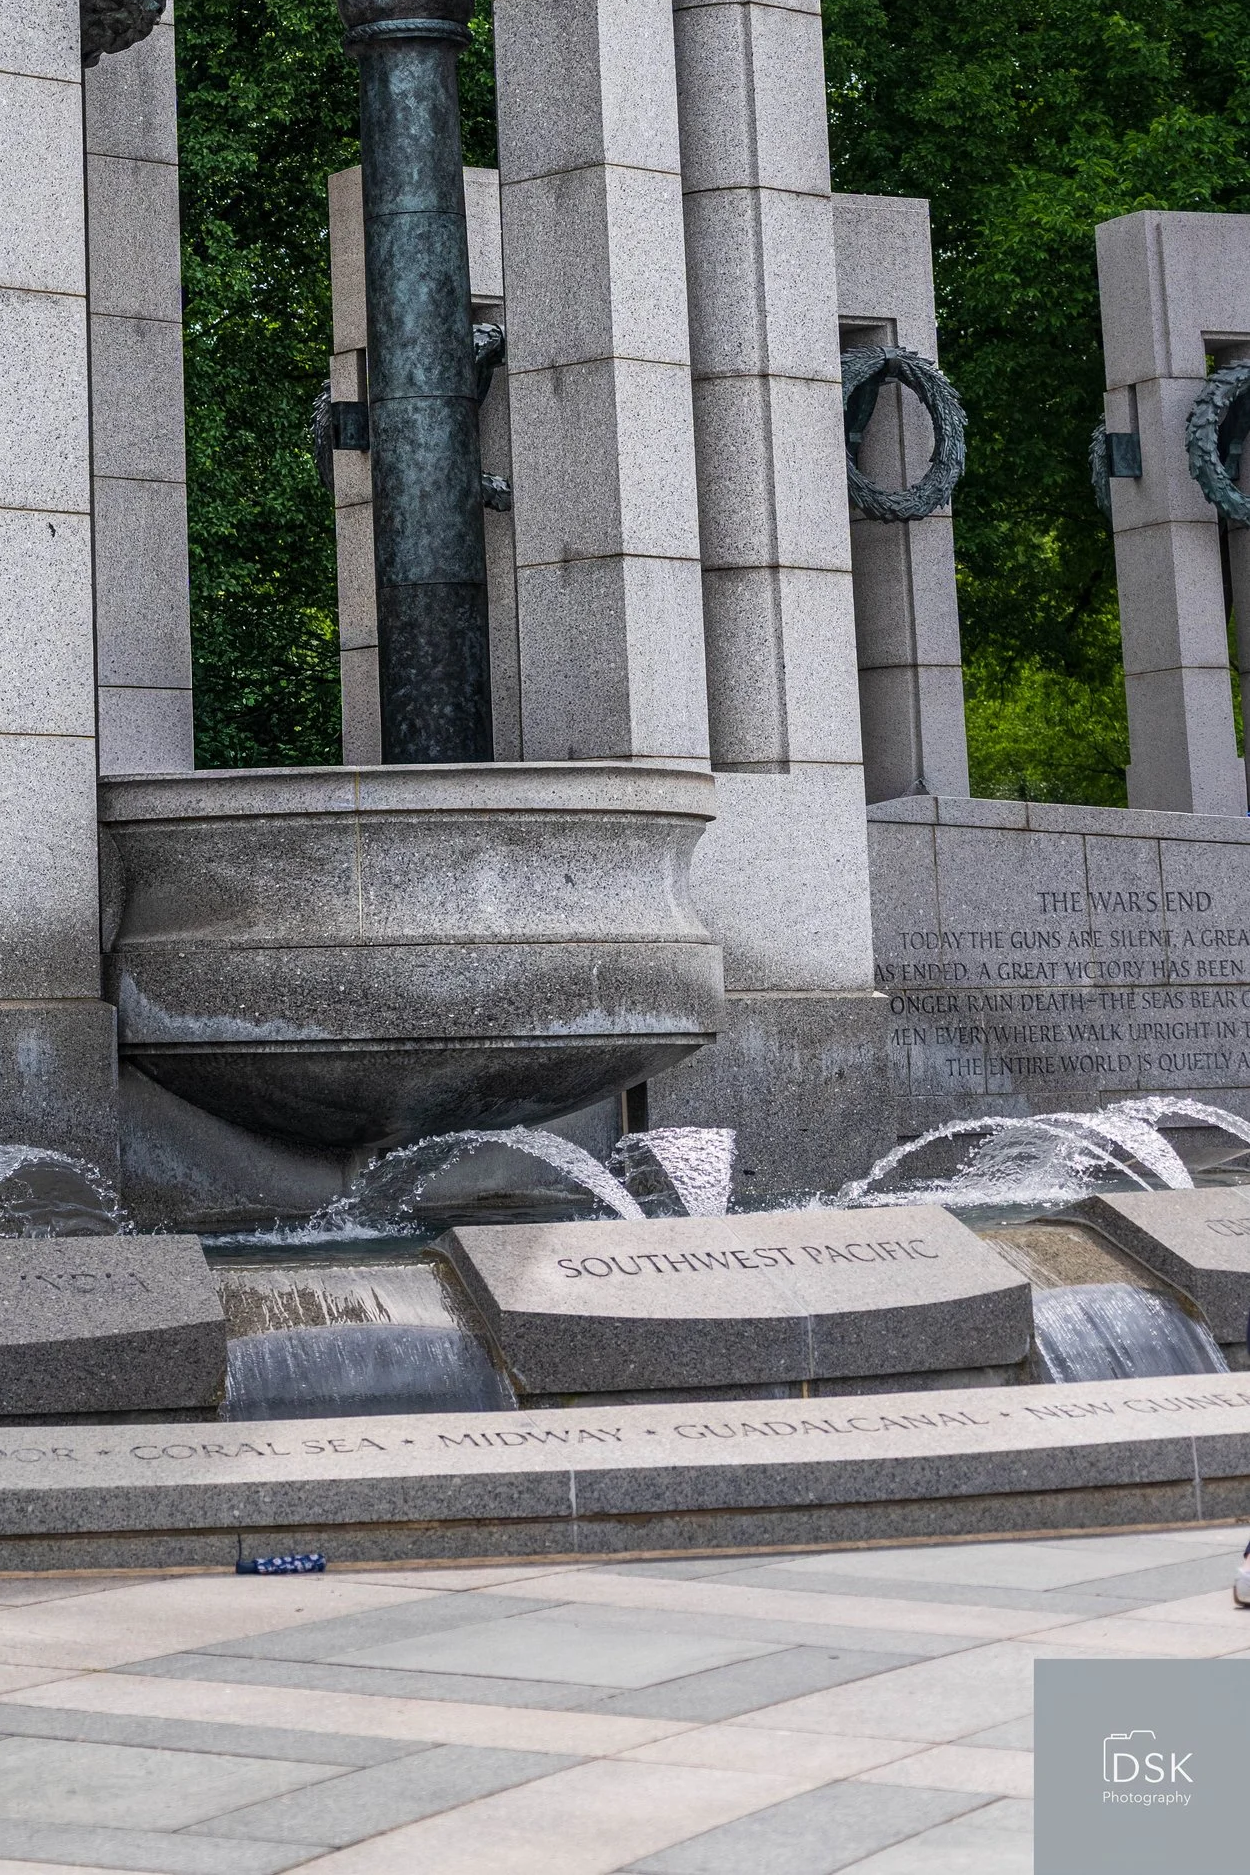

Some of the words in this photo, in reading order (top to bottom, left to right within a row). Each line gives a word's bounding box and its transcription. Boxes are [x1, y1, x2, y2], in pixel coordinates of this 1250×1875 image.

[1037, 892, 1083, 913] THE
[1089, 891, 1158, 913] WAR'S
[1165, 891, 1212, 912] END
[900, 931, 963, 950] TODAY
[968, 931, 1004, 949] THE
[1010, 931, 1061, 949] GUNS
[1067, 930, 1102, 948] ARE
[1110, 930, 1177, 948] SILENT.
[1184, 930, 1195, 947] A
[902, 962, 969, 982] ENDED.
[980, 962, 996, 980] A
[998, 962, 1059, 980] GREAT
[1065, 960, 1145, 979] VICTORY
[1152, 960, 1189, 978] HAS
[1197, 959, 1243, 977] BEEN
[967, 994, 1012, 1013] RAIN
[1142, 991, 1184, 1009] SEAS
[1191, 991, 1237, 1008] BEAR
[935, 1025, 1064, 1045] EVERYWHERE
[1068, 1023, 1123, 1042] WALK
[1128, 1023, 1209, 1041] UPRIGHT
[1216, 1022, 1236, 1039] IN
[945, 1057, 983, 1076] THE
[989, 1056, 1054, 1075] ENTIRE
[1060, 1054, 1132, 1073] WORLD
[1138, 1053, 1151, 1071] IS
[1158, 1051, 1232, 1072] QUIETLY
[556, 1247, 795, 1279] SOUTHWEST
[800, 1239, 940, 1265] PACIFIC
[18, 1272, 150, 1295] INDIA
[131, 1441, 293, 1462] CORAL
[301, 1437, 388, 1456] SEA
[436, 1426, 625, 1449] MIDWAY
[673, 1410, 991, 1440] GUADALCANAL
[1024, 1398, 1116, 1421] NEW
